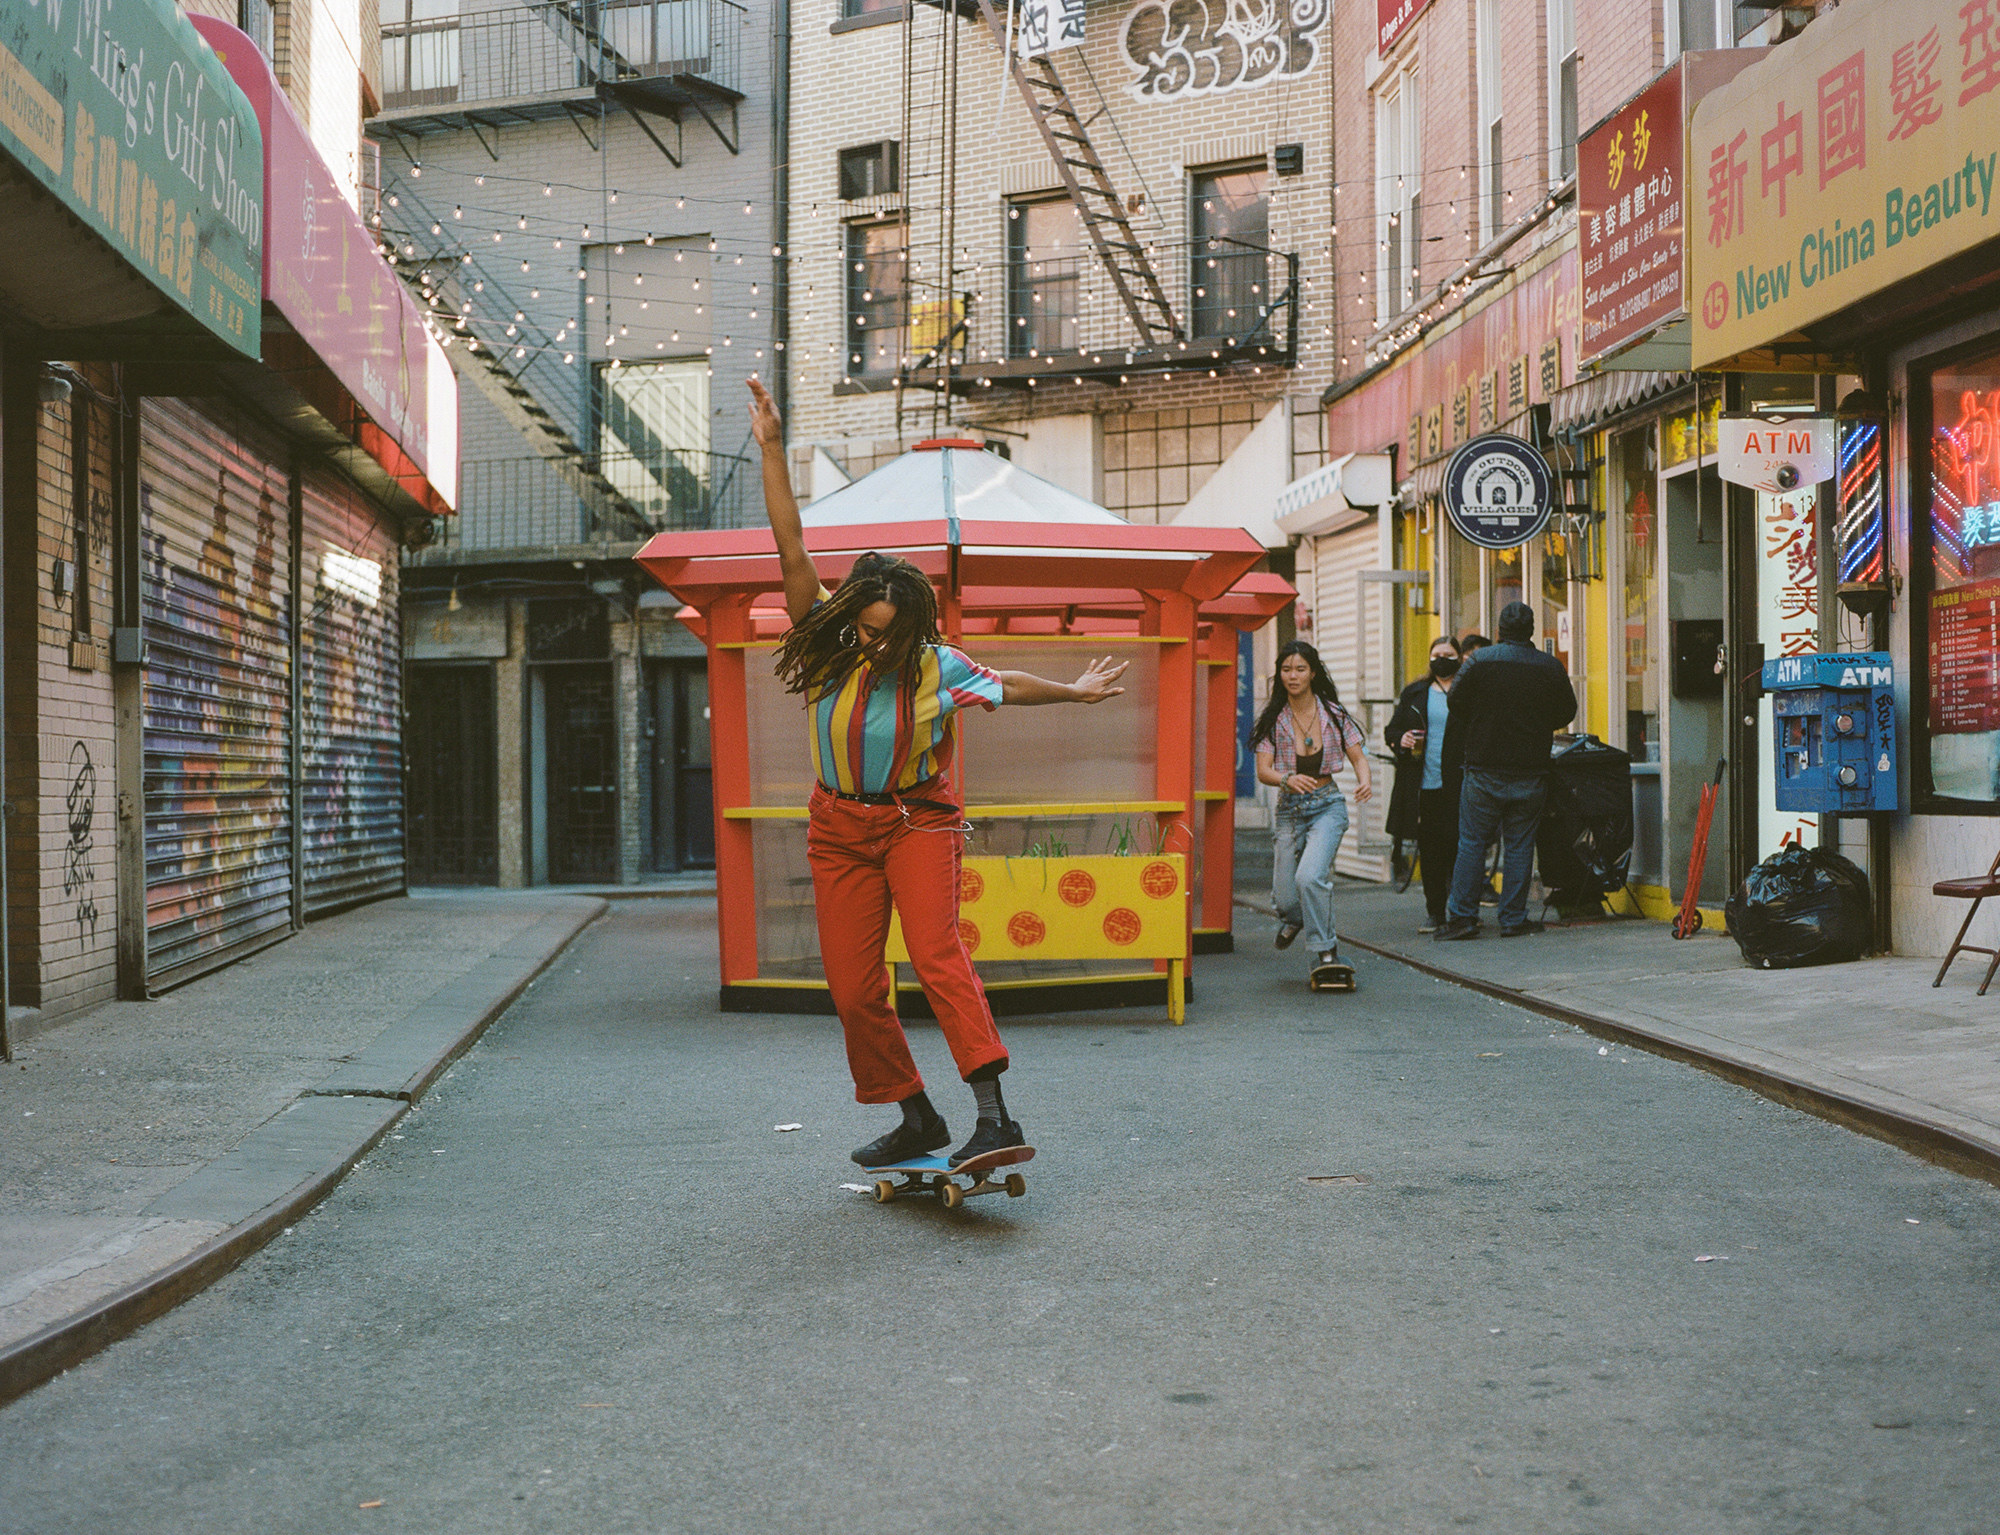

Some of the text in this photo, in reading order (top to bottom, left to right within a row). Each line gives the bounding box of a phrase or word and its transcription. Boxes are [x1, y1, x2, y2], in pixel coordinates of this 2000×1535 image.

[163, 60, 206, 192] Gift
[211, 115, 260, 265] Shop
[1736, 260, 1792, 320] New
[1799, 218, 1876, 289] China
[1885, 149, 1998, 249] Beauty
[1744, 432, 1811, 454] ATM
[1478, 456, 1532, 487] OUTDOOR
[1463, 505, 1536, 516] VILLAGES
[1777, 659, 1891, 686] ATM ATM
